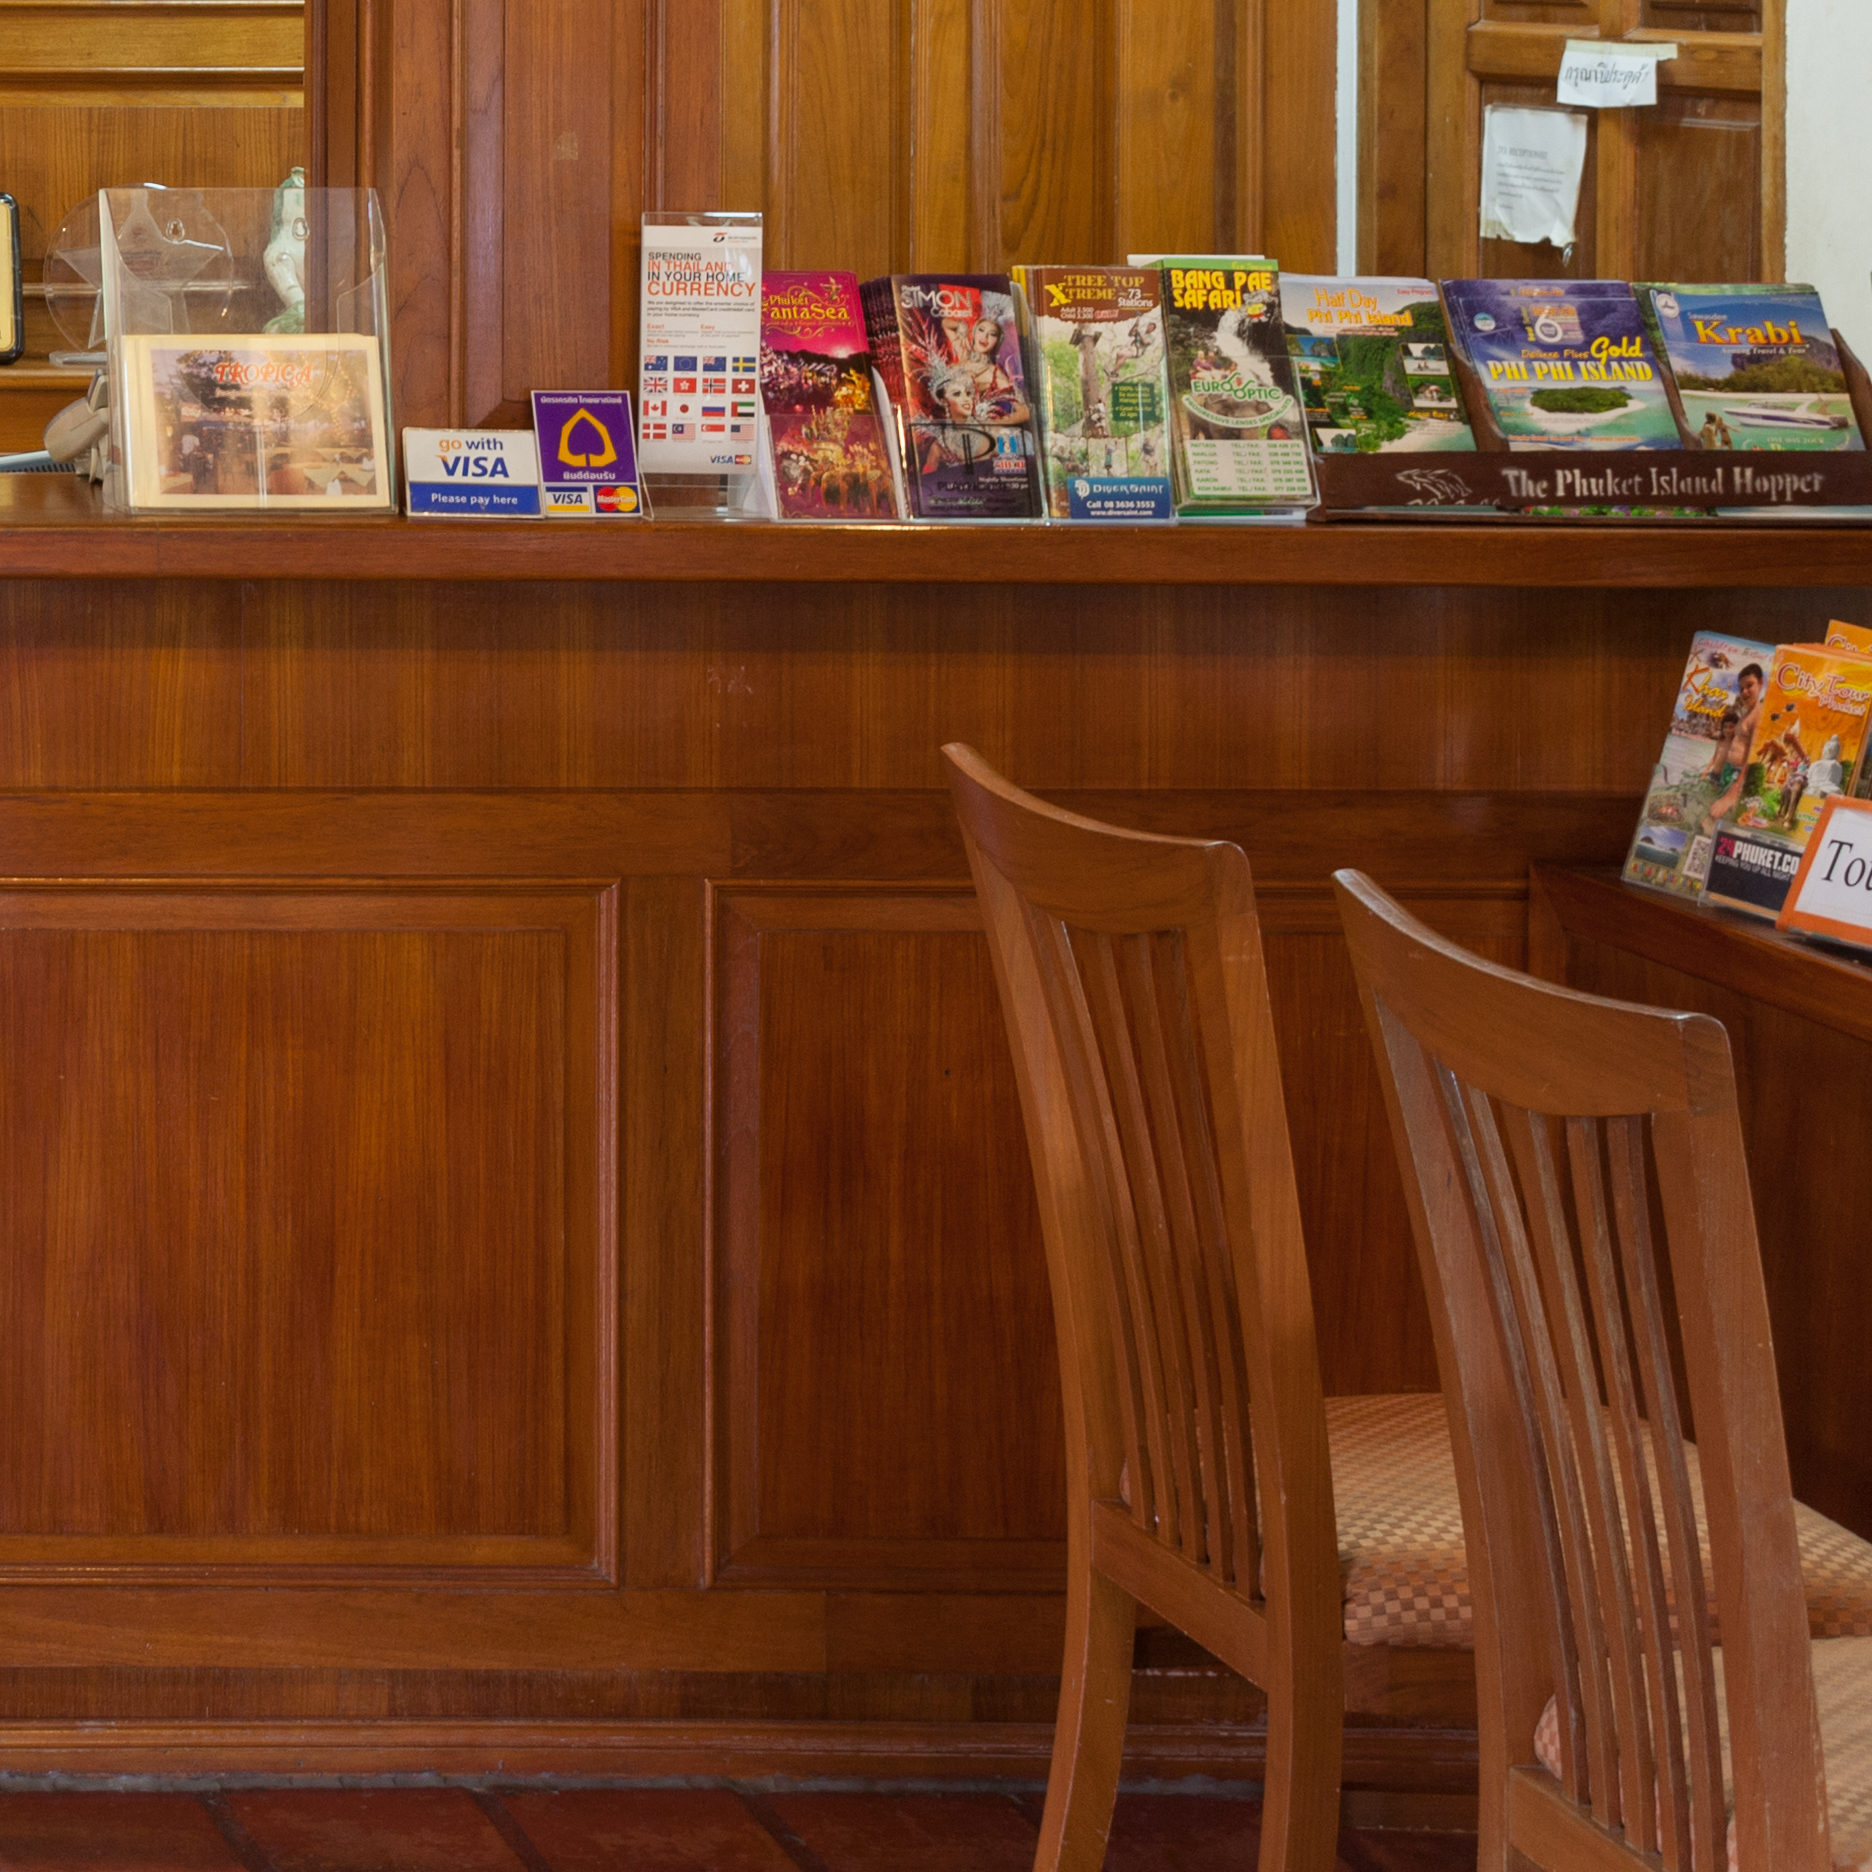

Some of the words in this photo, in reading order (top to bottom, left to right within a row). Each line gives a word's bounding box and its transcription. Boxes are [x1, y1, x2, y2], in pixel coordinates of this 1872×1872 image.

[648, 252, 702, 260] SPENDING
[648, 261, 660, 271] IN
[666, 261, 734, 272] THAILAND
[648, 272, 660, 281] IN
[665, 272, 701, 281] YOUR
[706, 272, 744, 282] HOME
[1064, 275, 1108, 287] TREE
[1111, 276, 1145, 287] TOP
[1171, 269, 1225, 290] BANG
[1234, 271, 1273, 291] PAE
[647, 282, 756, 297] CURRENCY
[1128, 288, 1141, 300] 73
[769, 295, 808, 305] Phuket
[901, 289, 972, 308] SIMON
[1118, 297, 1153, 307] Stations
[1173, 289, 1242, 310] SAFARI
[1314, 288, 1345, 307] Half
[1347, 288, 1378, 311] Day
[930, 306, 973, 318] Cabaret
[1308, 309, 1333, 323] Phi
[1337, 310, 1363, 324] Phi
[1366, 310, 1414, 327] Island
[1691, 318, 1806, 346] Krabi
[1521, 350, 1560, 359] Deluxe
[1564, 349, 1589, 359] Plus
[1590, 336, 1644, 366] Gold
[215, 361, 313, 387] TROPICA
[1487, 360, 1529, 380] PHI
[1532, 361, 1575, 381] PHI
[1577, 361, 1653, 381] ISLAND
[1232, 380, 1283, 401] OPTIC
[1185, 397, 1230, 425] PROGRESSIVE
[1258, 397, 1292, 425] SPECIALISTS
[439, 439, 462, 452] go
[466, 438, 503, 451] with
[436, 455, 509, 478] VISA
[710, 456, 733, 464] VISA
[1501, 468, 1548, 498] The
[1556, 467, 1643, 497] Phuket
[1650, 467, 1723, 496] Island
[1732, 466, 1825, 502] Hopper
[431, 493, 467, 503] Please
[471, 494, 490, 505] pay
[493, 494, 518, 504] here
[552, 494, 583, 504] VISA
[596, 494, 637, 504] MasterCard
[1087, 500, 1101, 509] Call
[1104, 501, 1115, 509] 08
[1117, 501, 1135, 509] 3636
[1137, 501, 1155, 509] 3553
[1776, 662, 1823, 697] City
[1825, 672, 1870, 703] Tour
[1717, 837, 1800, 874] 24PHUKET.CO
